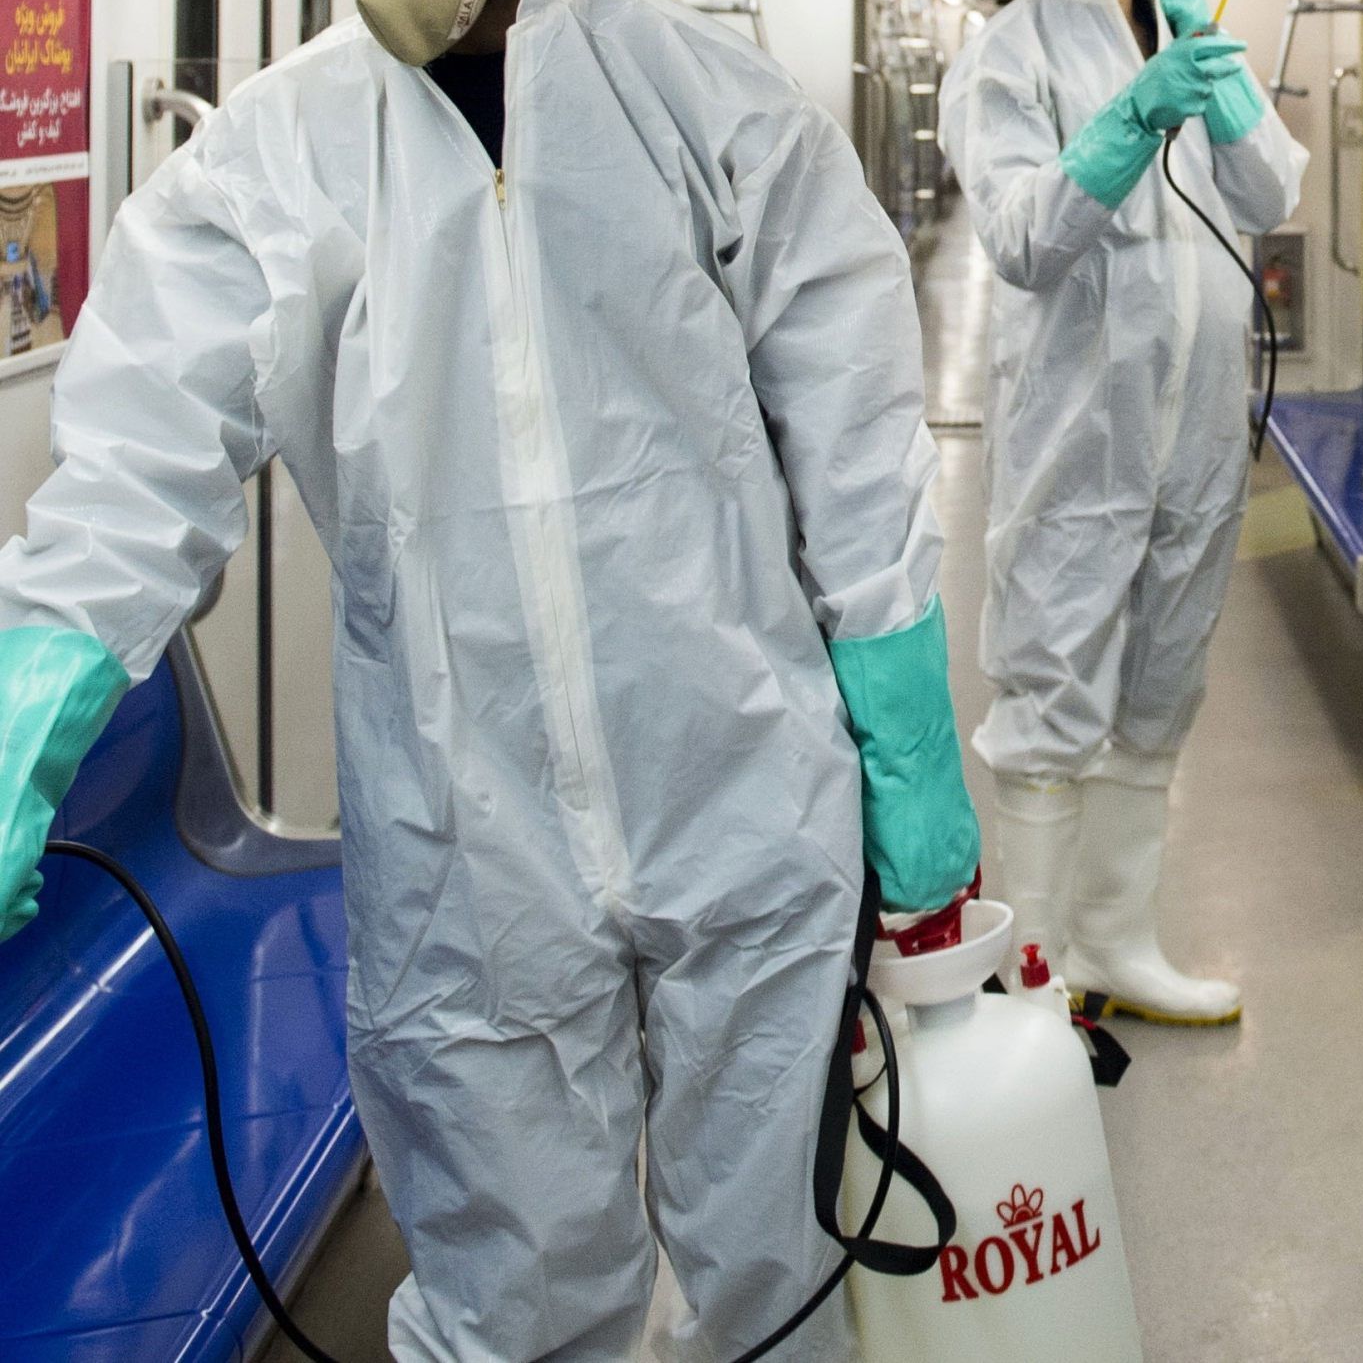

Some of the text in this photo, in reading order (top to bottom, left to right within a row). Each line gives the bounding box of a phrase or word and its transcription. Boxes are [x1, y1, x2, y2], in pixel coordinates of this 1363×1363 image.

[15, 0, 65, 35] فروش ویژه
[5, 38, 73, 75] پوشاک ایرانیان
[939, 1199, 1101, 1302] ROYAL
